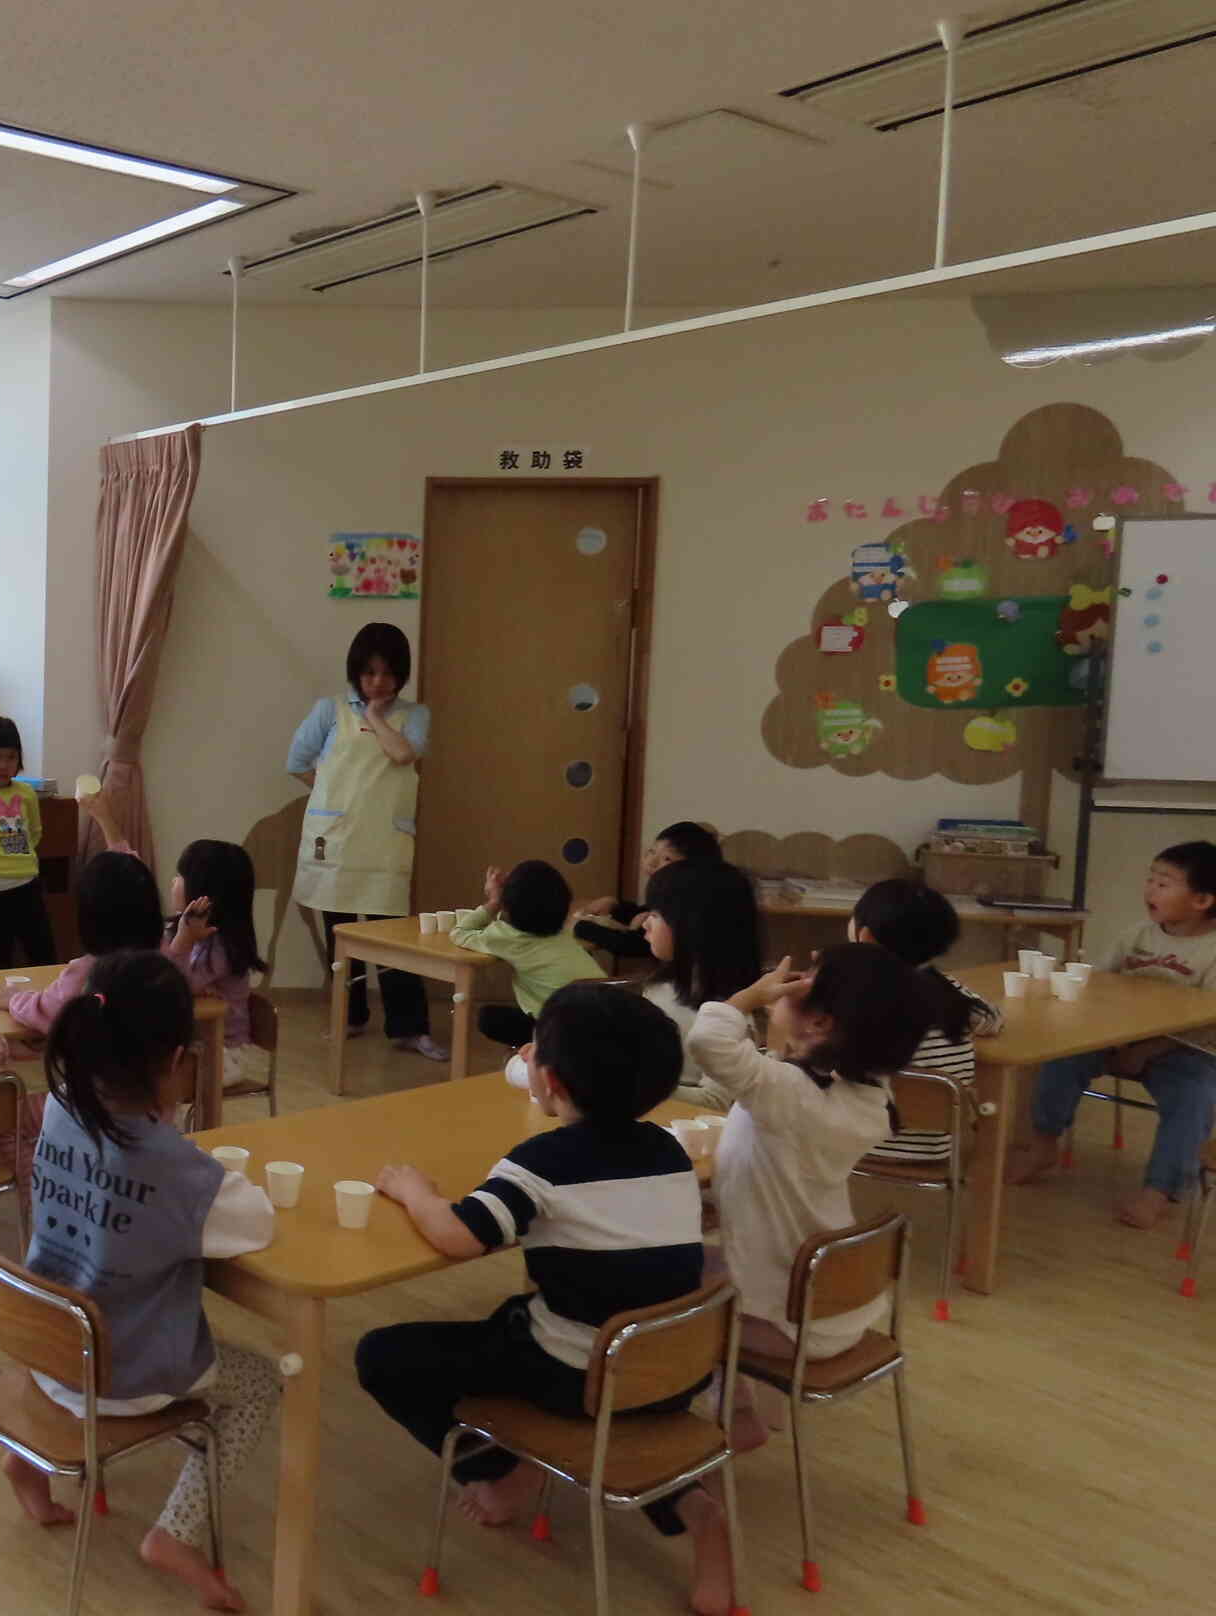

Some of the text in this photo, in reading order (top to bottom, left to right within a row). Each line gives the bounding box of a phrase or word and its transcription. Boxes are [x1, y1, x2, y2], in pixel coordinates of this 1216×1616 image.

[498, 450, 583, 470] 救助袋
[84, 1152, 156, 1205] Your
